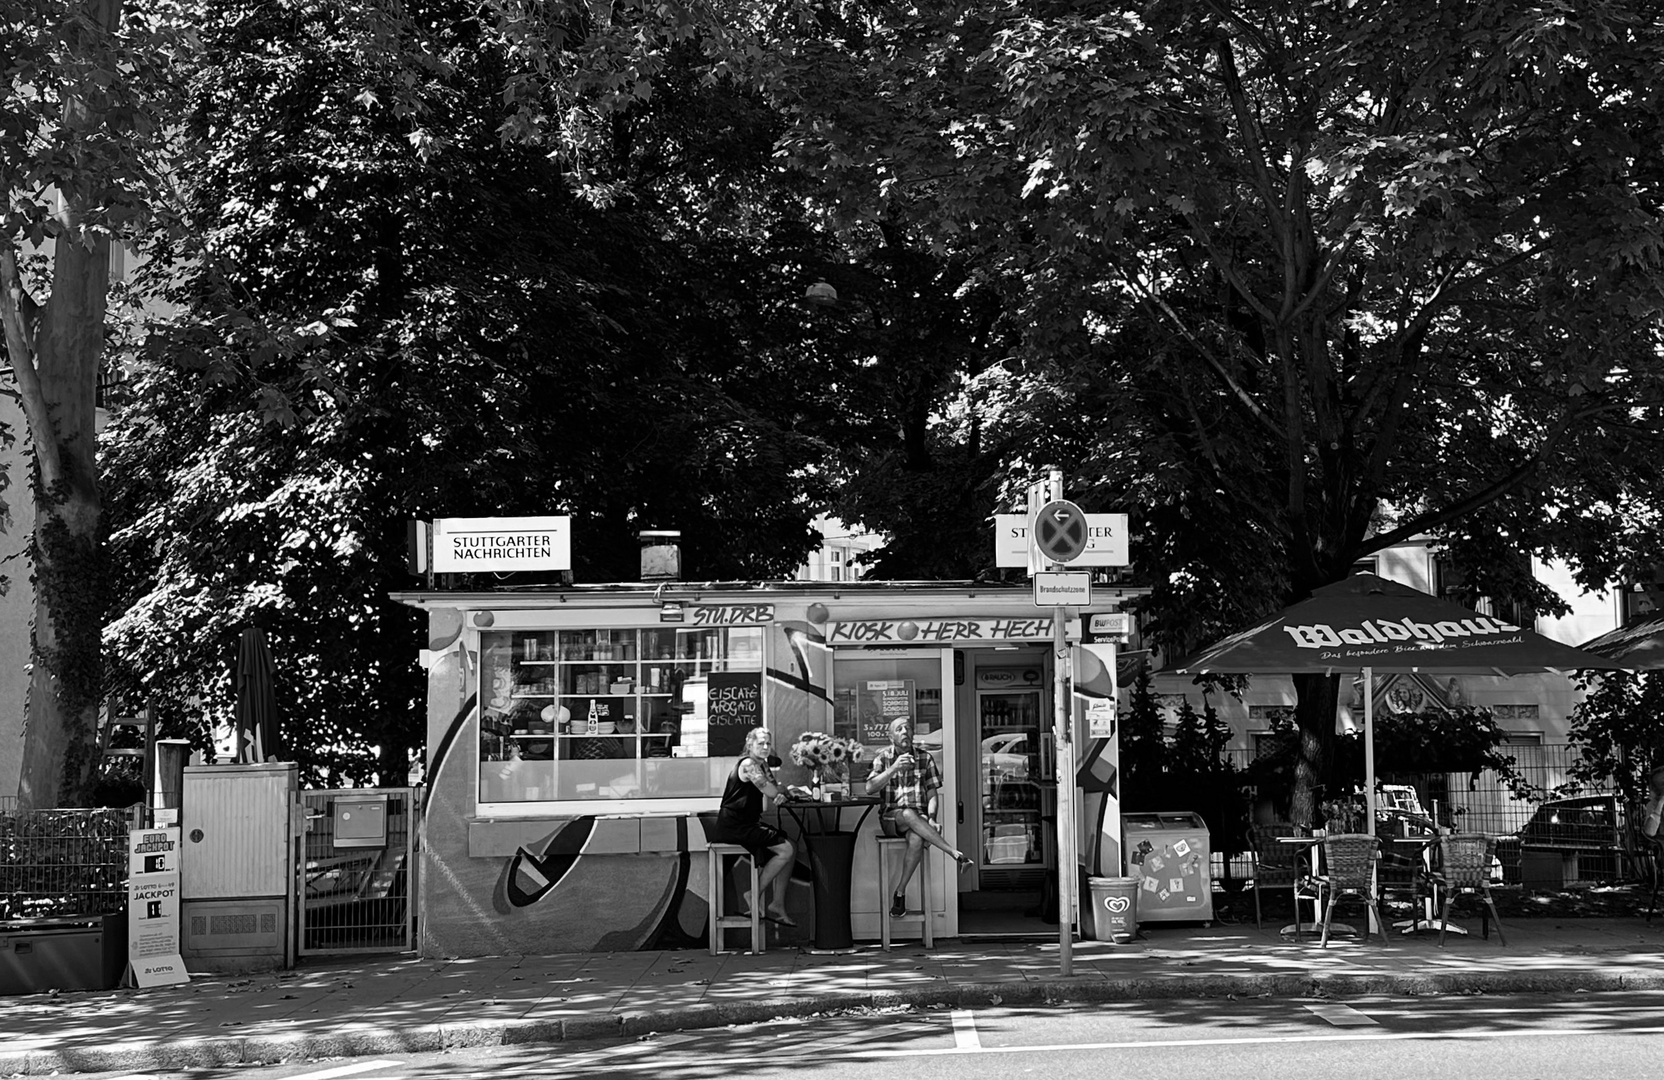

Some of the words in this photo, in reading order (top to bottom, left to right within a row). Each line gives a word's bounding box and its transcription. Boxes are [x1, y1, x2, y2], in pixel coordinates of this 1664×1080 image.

[453, 535, 551, 548] STUTTGARTER
[453, 547, 551, 560] NACHRICHTEN
[1039, 584, 1086, 594] Brandschutzzone
[830, 621, 894, 641] KIOSK
[921, 621, 983, 641] HERR
[1283, 617, 1521, 649] Waldhaus
[1320, 651, 1342, 660] Das
[1346, 647, 1389, 657] besondere
[1393, 644, 1416, 653] Bier
[1461, 636, 1525, 649] Schwarzwald
[143, 833, 168, 844] EURO
[134, 840, 175, 854] JACKPOT
[140, 883, 157, 891] LOTTO
[133, 889, 175, 900] JACKPOT
[152, 965, 174, 973] LOTTO
